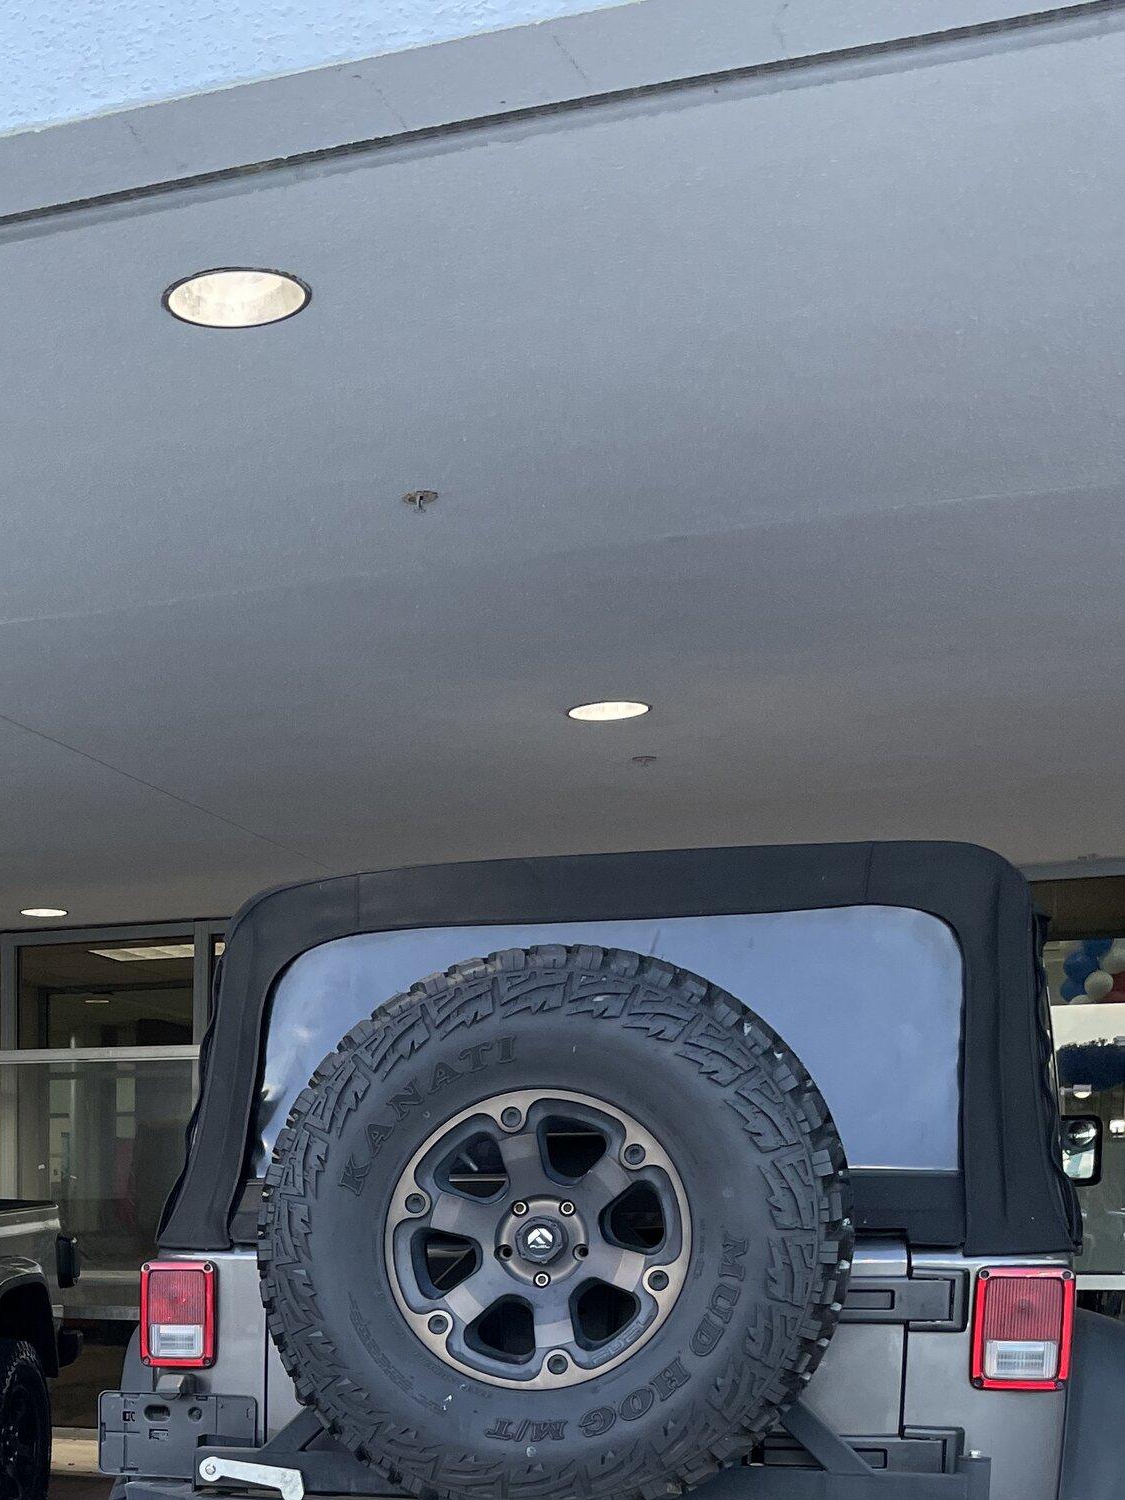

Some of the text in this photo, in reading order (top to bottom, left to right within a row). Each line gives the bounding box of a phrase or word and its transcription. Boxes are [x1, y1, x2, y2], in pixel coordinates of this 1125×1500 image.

[338, 1035, 516, 1196] KANATI
[689, 1233, 748, 1357] MUD
[592, 1313, 655, 1365] FUEL
[485, 1419, 567, 1442] M/T
[579, 1358, 691, 1437] HOG
